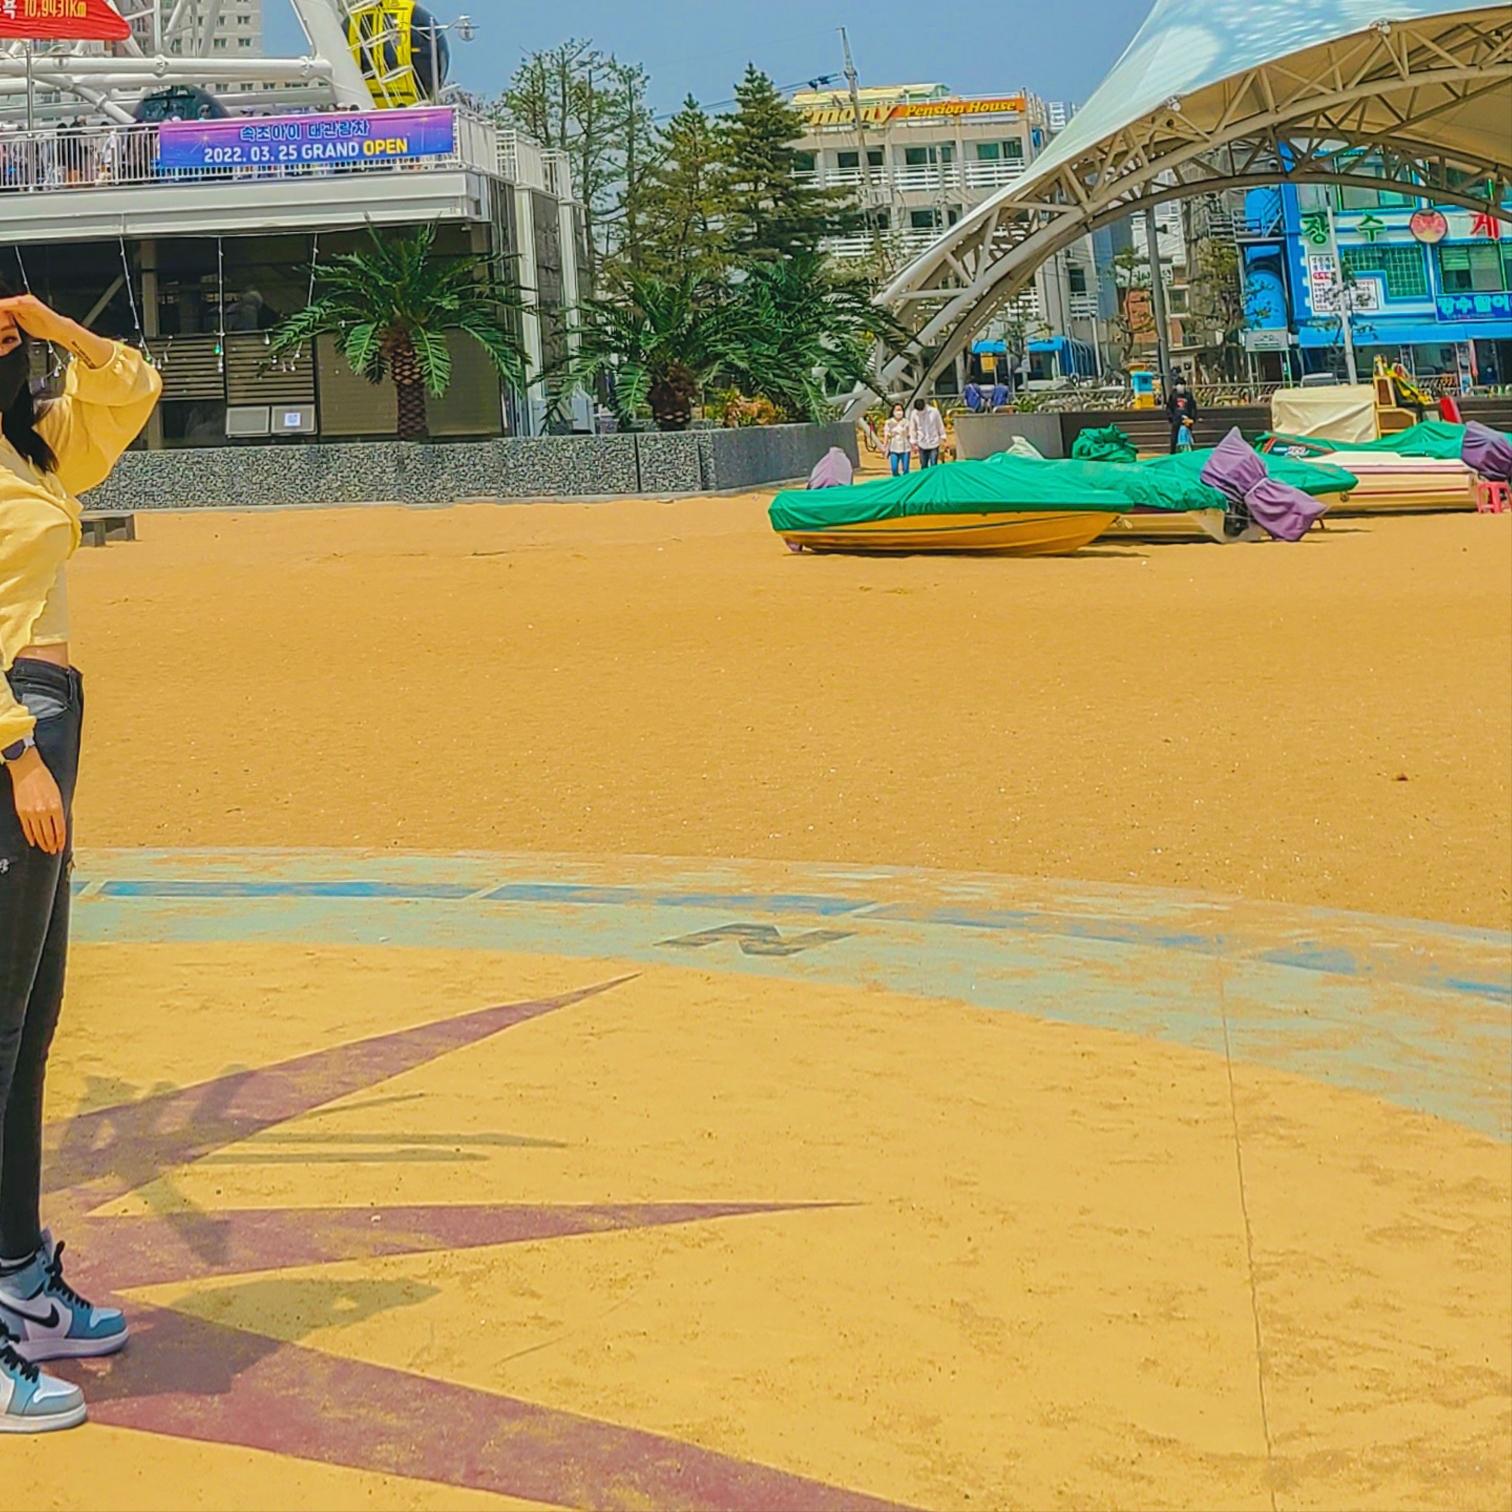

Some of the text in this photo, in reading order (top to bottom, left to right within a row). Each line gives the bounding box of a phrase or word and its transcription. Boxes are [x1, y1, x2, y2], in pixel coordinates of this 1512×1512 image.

[905, 101, 965, 117] Pension
[966, 100, 1017, 114] House
[240, 119, 370, 142] 속초아이 대관람차
[204, 138, 409, 163] 2022. 03. 25 GRAND OPEN
